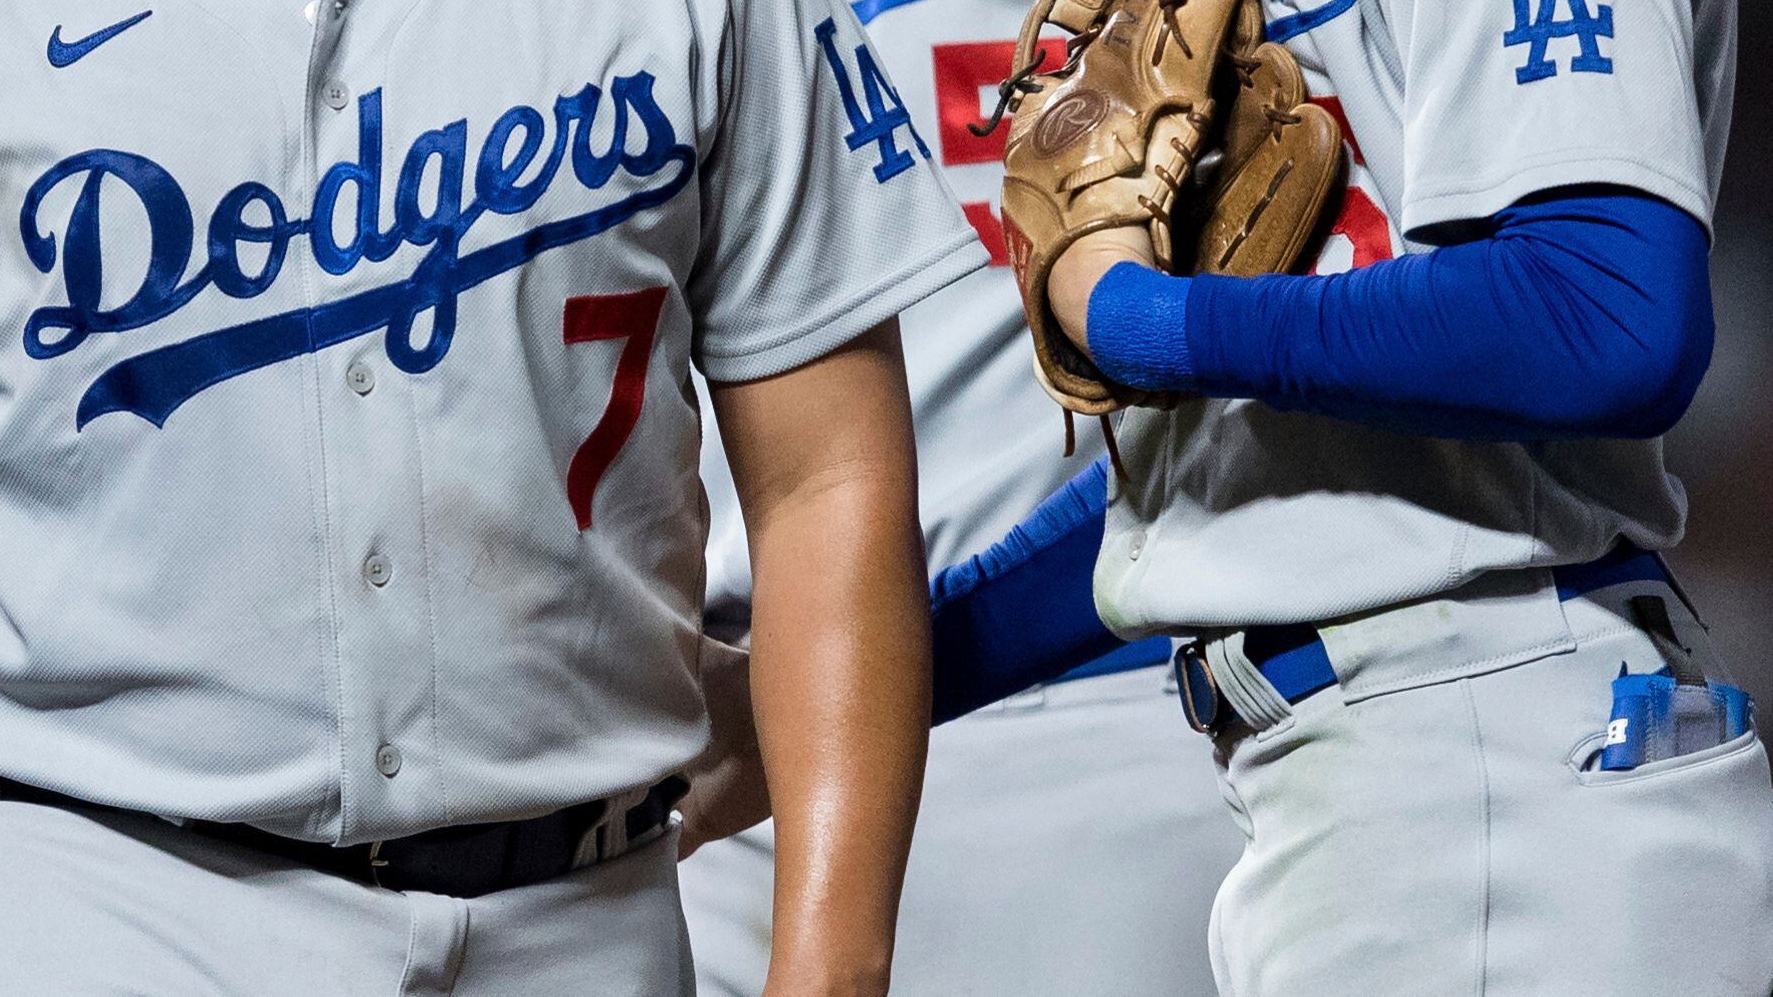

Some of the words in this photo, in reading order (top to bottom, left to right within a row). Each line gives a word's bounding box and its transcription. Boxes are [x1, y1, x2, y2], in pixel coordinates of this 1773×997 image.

[20, 70, 697, 376] Dodgers
[814, 16, 932, 184] LA
[564, 287, 668, 533] 7
